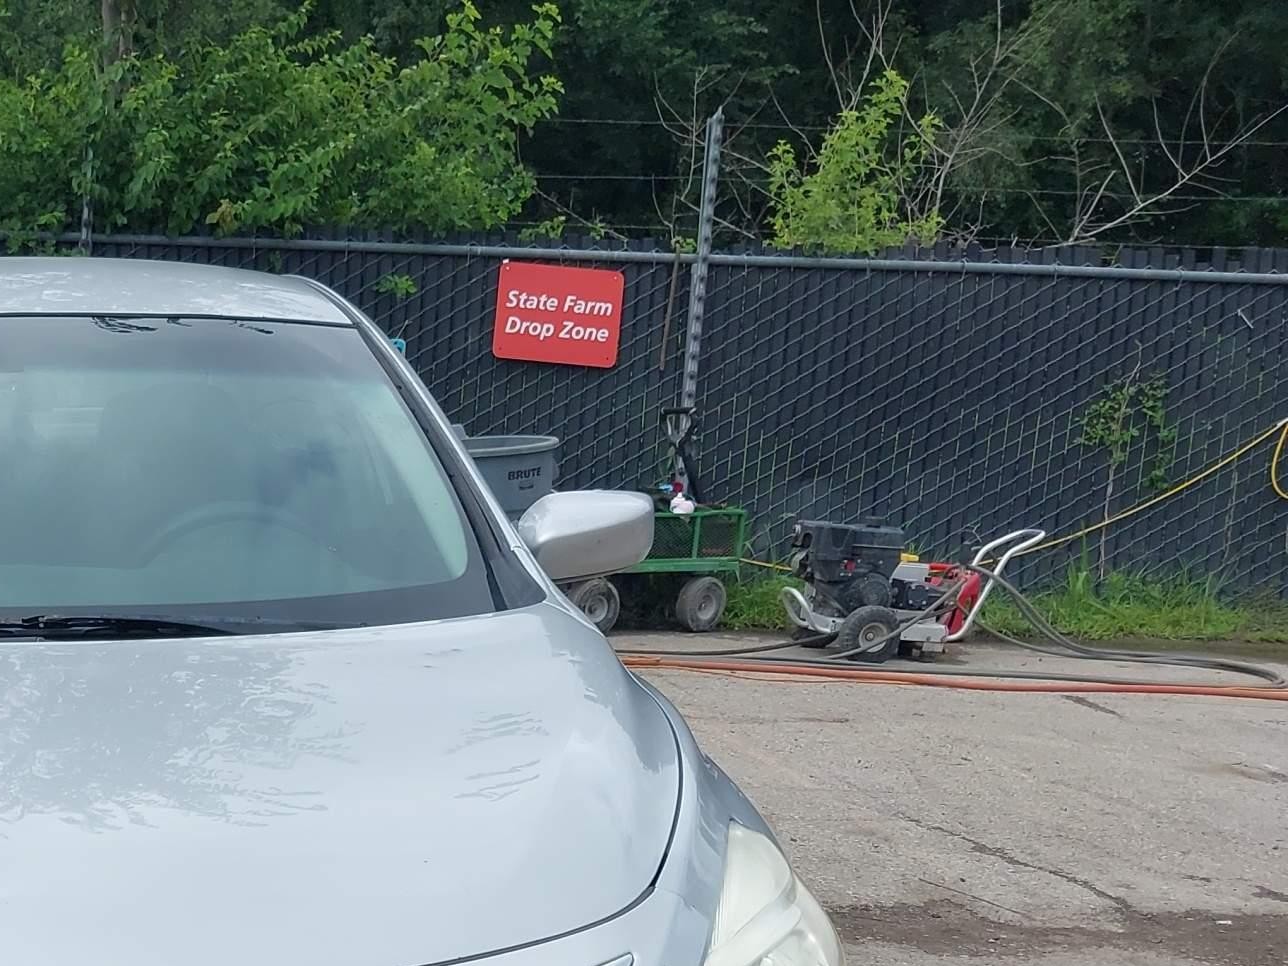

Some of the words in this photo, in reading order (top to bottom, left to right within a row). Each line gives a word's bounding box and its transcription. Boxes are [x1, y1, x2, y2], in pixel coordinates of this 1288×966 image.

[505, 289, 558, 312] State
[563, 295, 613, 317] Farm
[504, 316, 555, 341] Drop
[558, 321, 610, 342] Zone
[507, 466, 542, 481] BRUTE
